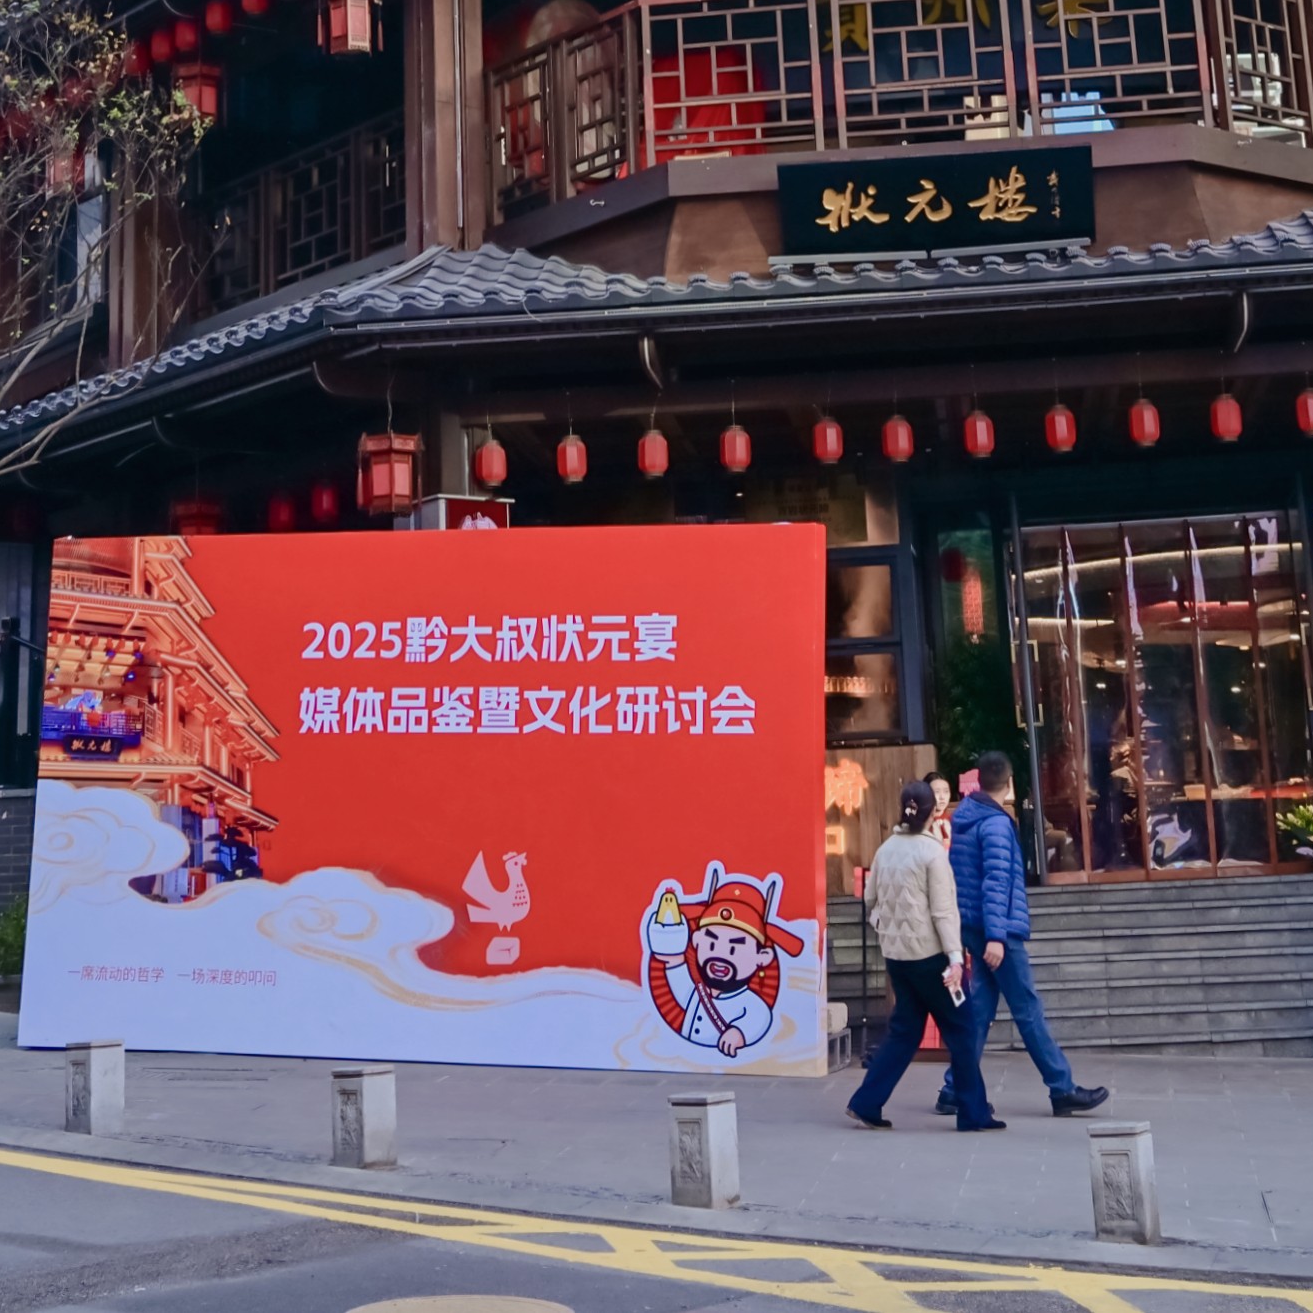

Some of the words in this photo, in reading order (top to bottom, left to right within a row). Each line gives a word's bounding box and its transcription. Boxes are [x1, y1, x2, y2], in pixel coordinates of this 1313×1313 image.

[300, 613, 679, 664] 2025黔大叔状元宴
[298, 685, 757, 735] 媒体品鉴暨文化研讨会
[68, 965, 165, 983] 一席流动的哲学
[177, 968, 277, 986] 一场深度的叩问
